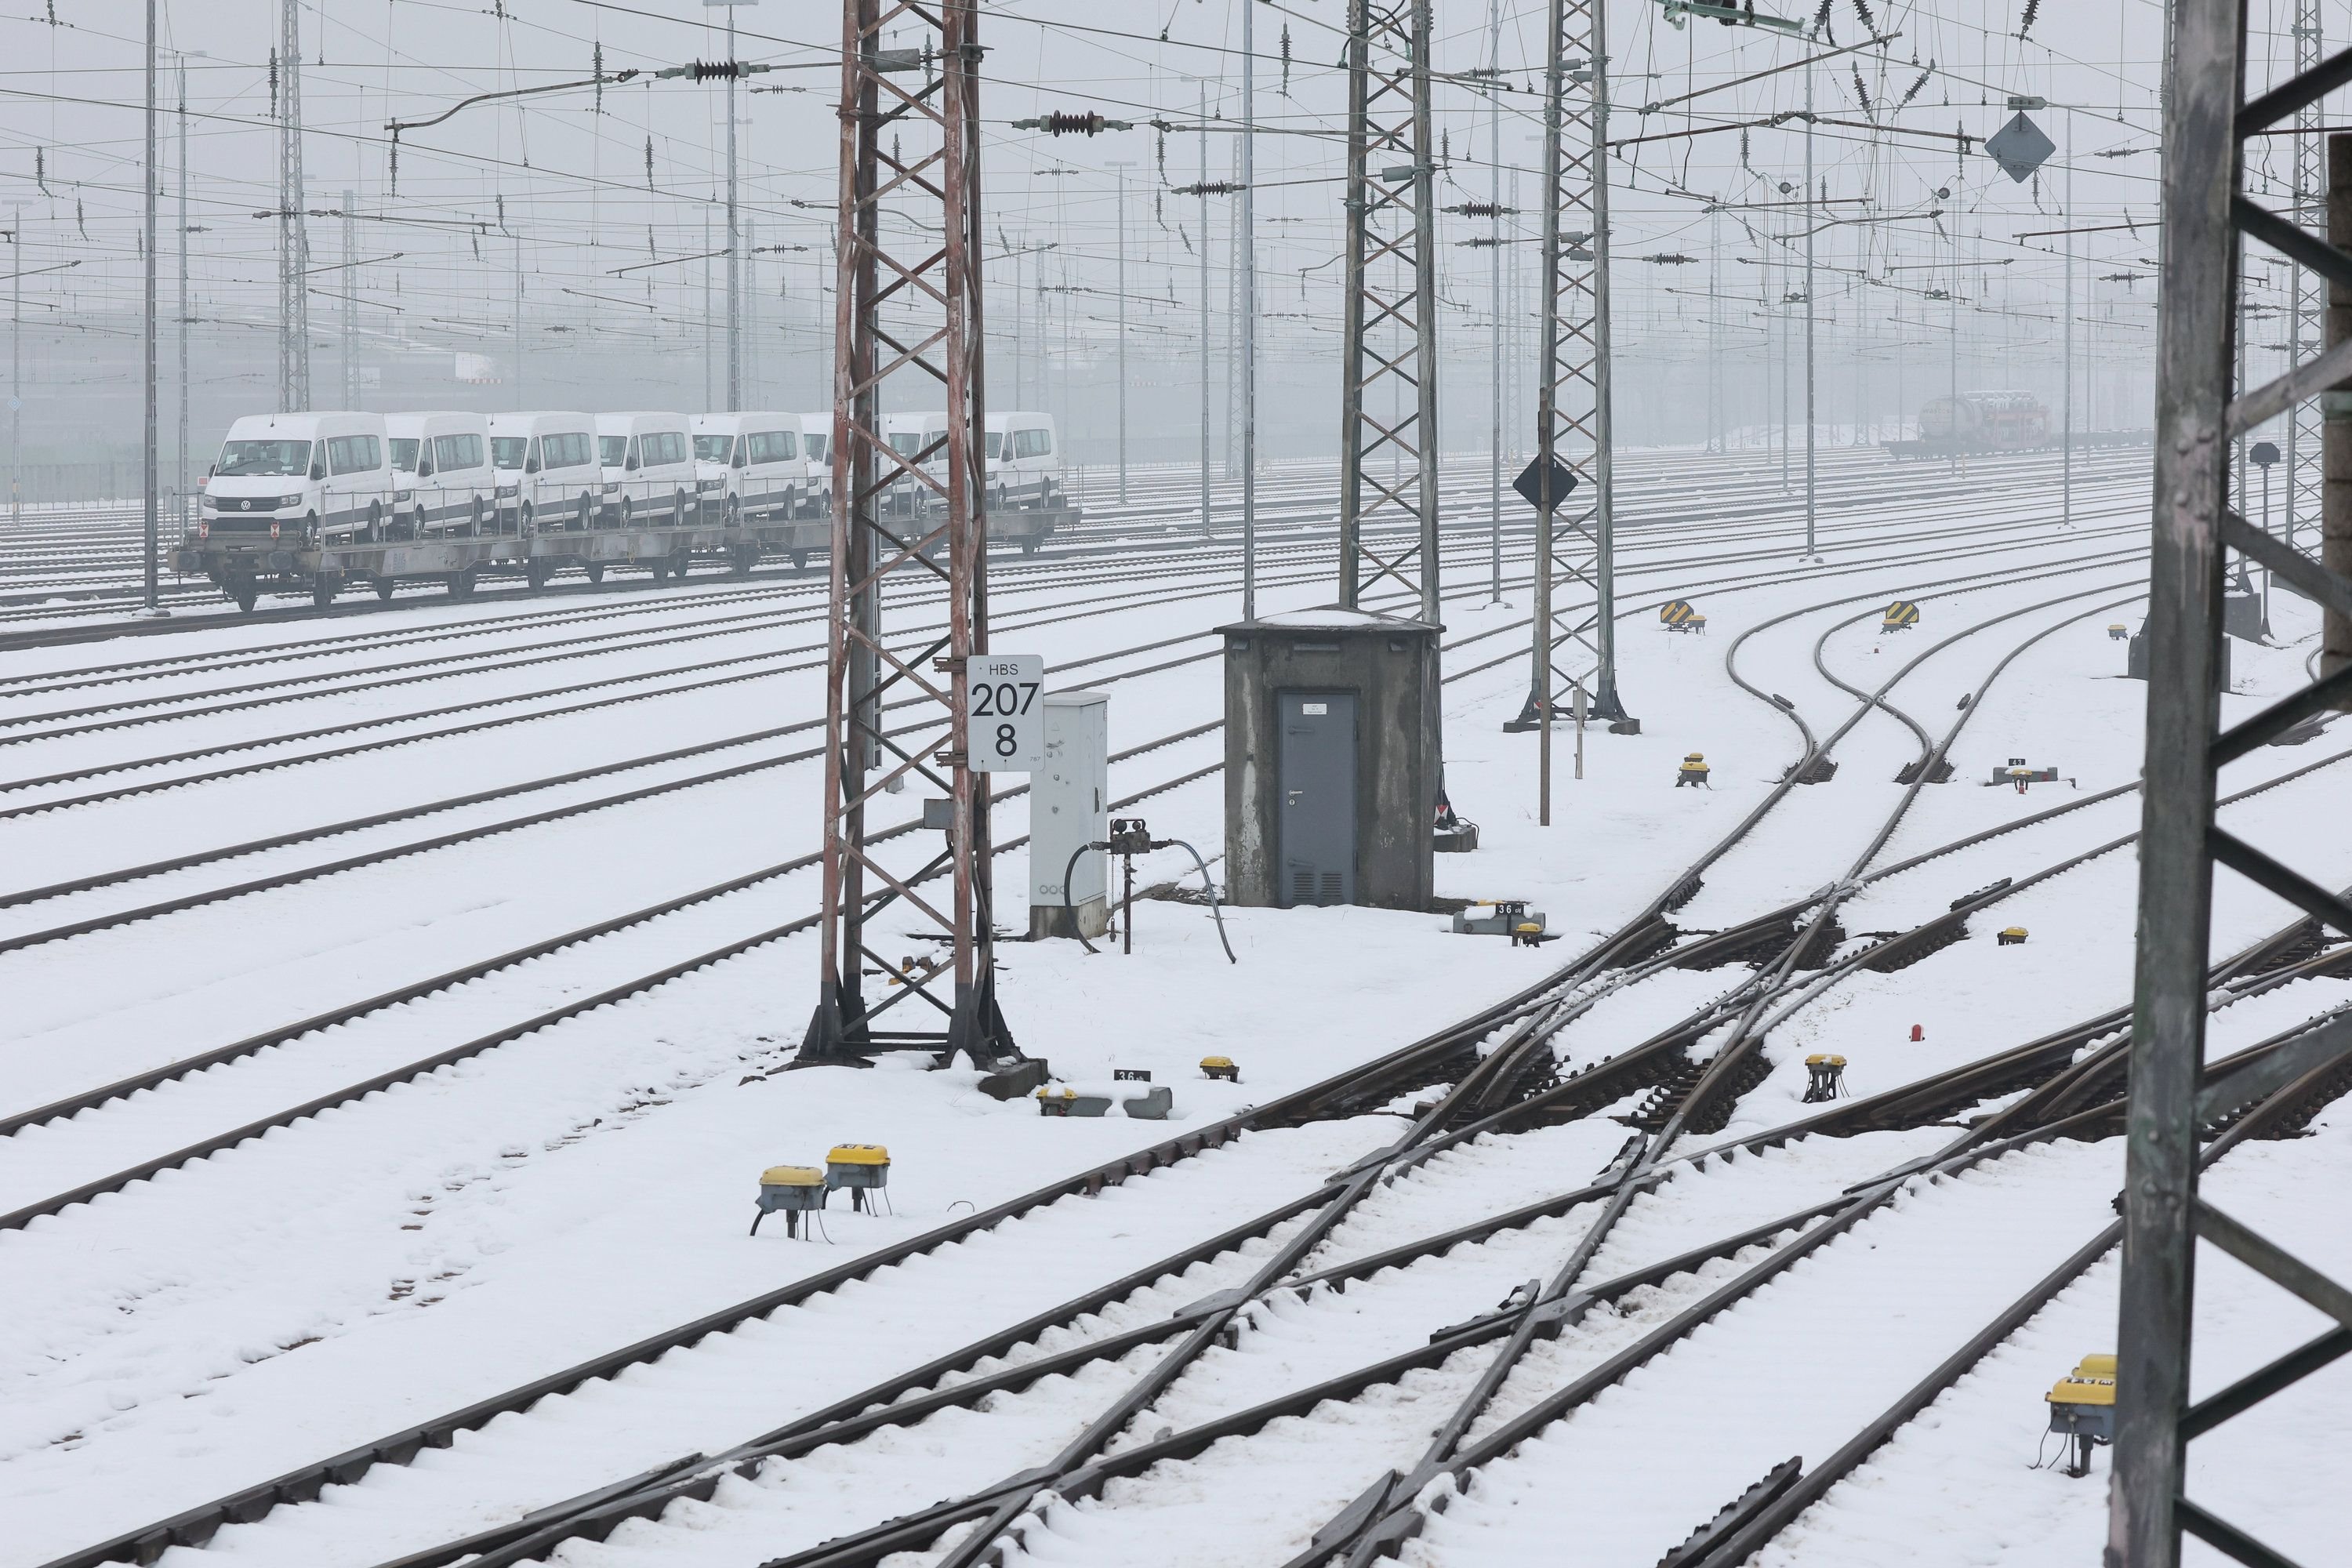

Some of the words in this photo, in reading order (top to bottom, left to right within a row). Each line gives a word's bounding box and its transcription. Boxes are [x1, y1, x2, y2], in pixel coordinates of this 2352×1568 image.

[989, 663, 1018, 676] HBS
[971, 682, 1040, 717] 207
[995, 723, 1018, 757] 8
[1499, 905, 1512, 914] 36
[1119, 1071, 1134, 1080] 36
